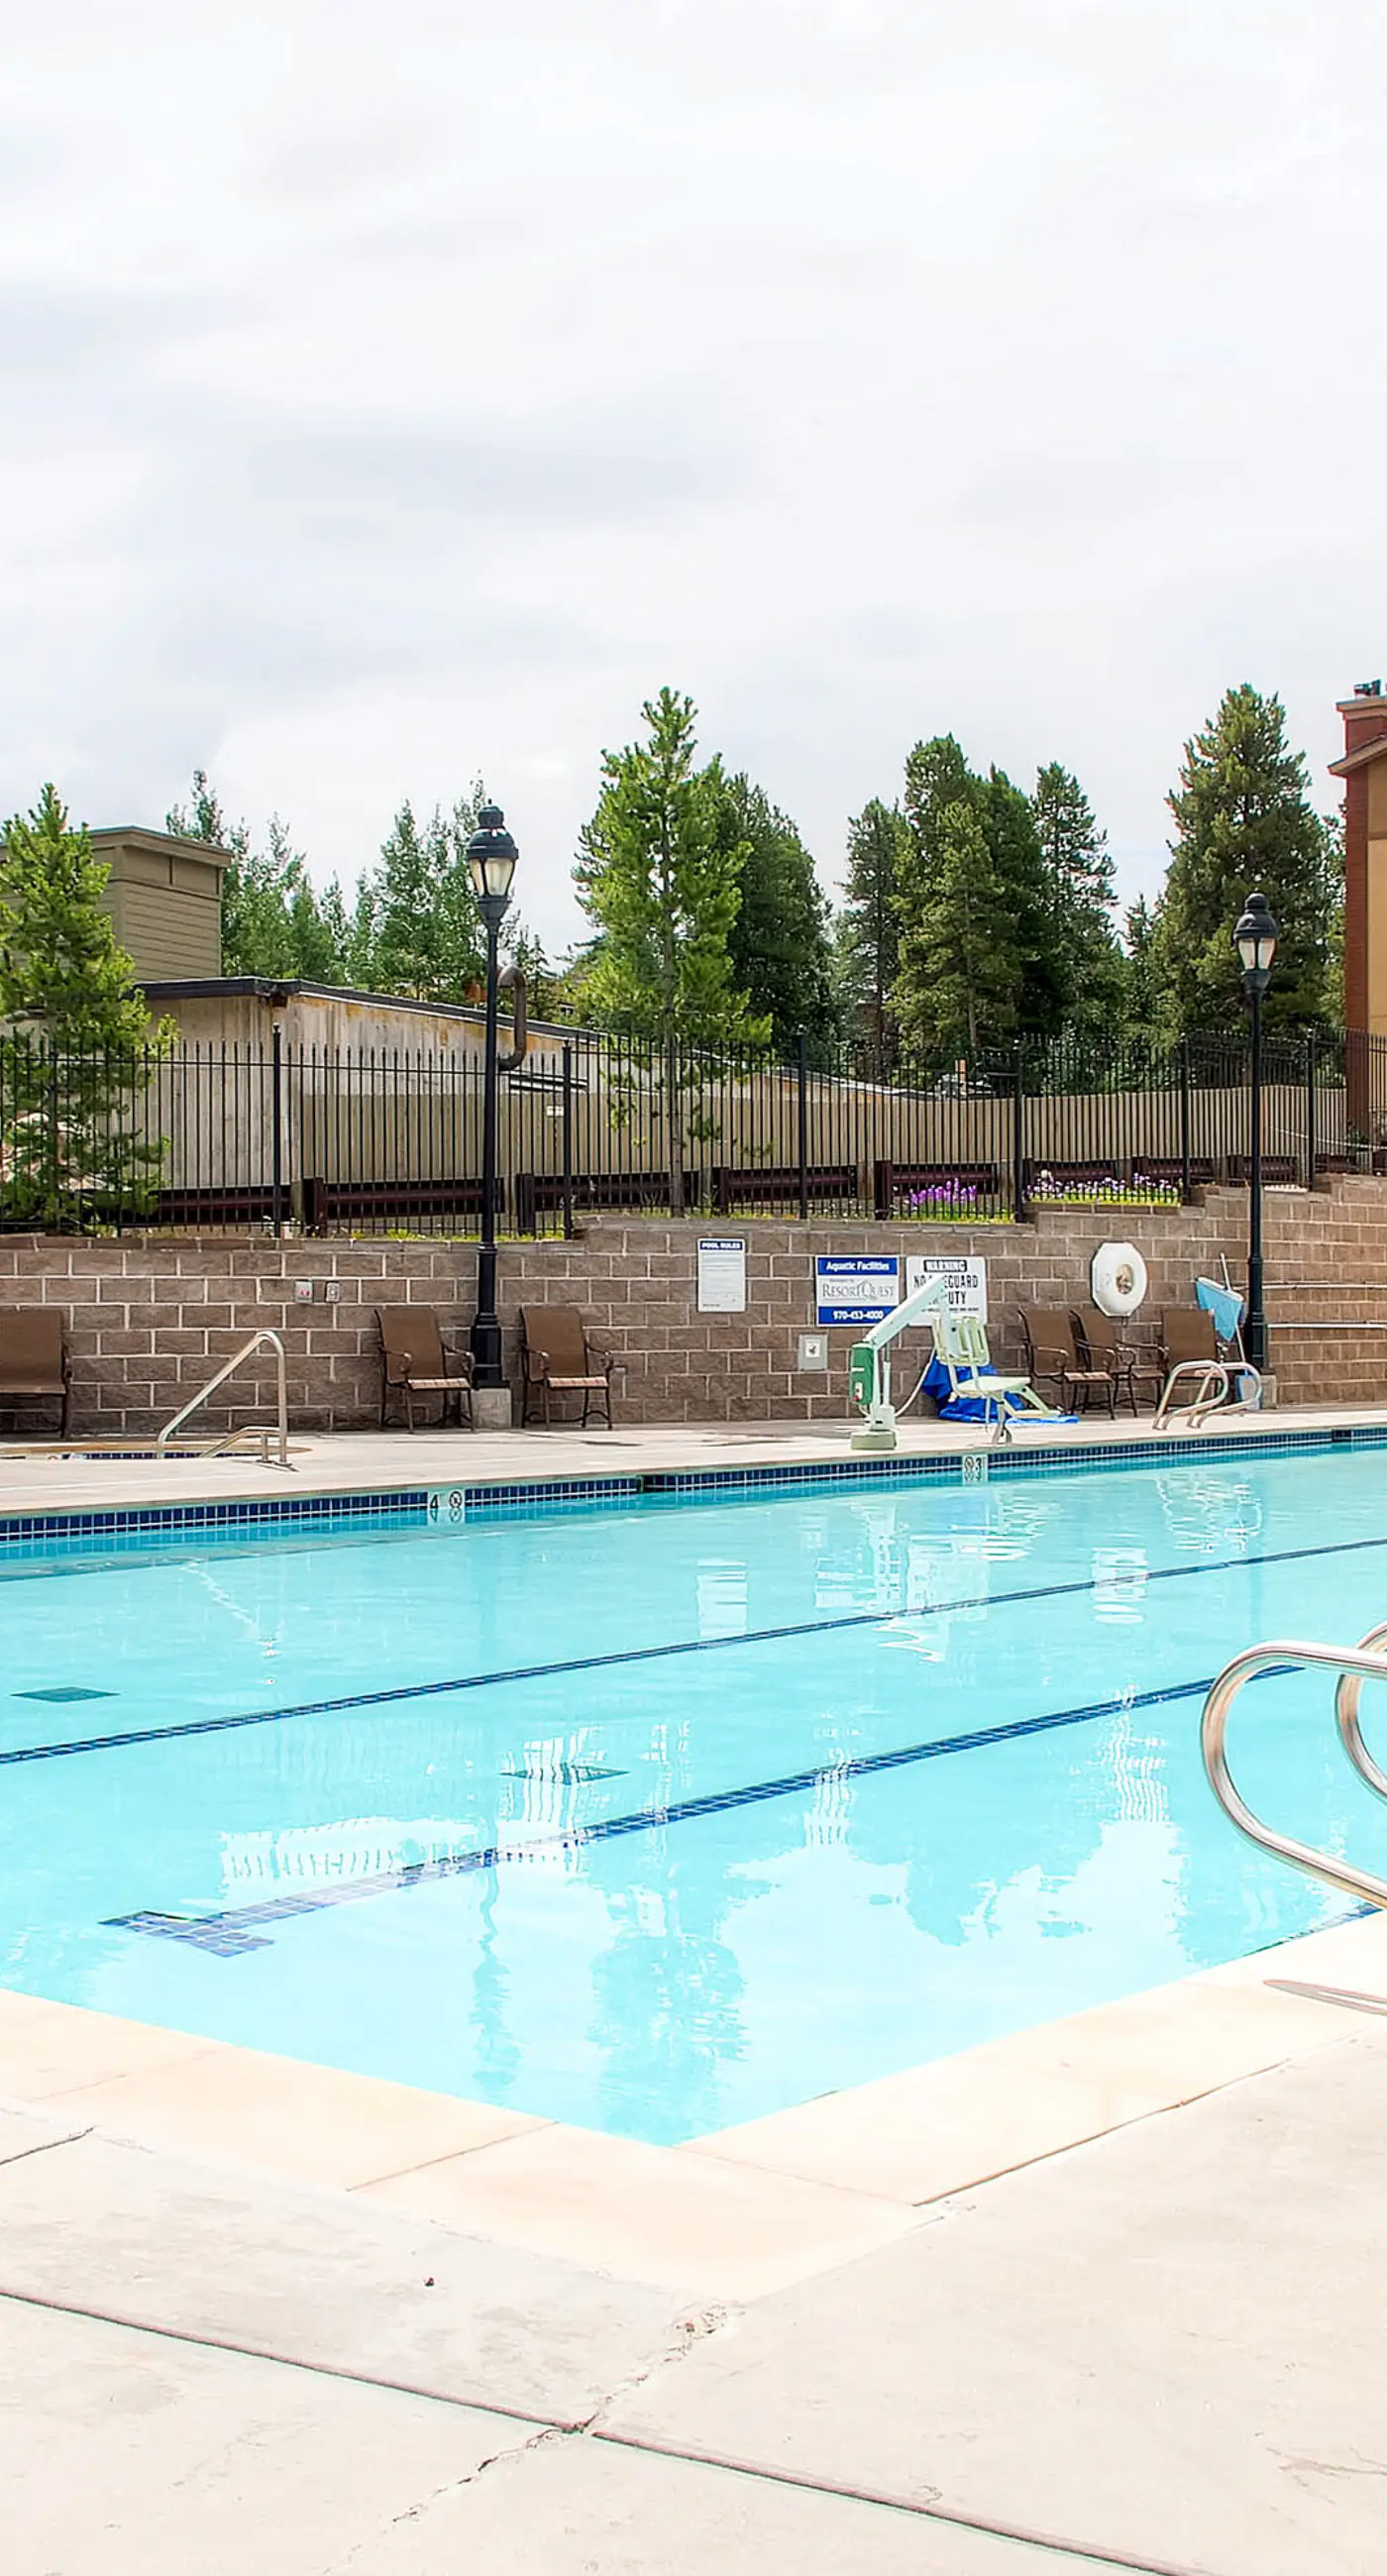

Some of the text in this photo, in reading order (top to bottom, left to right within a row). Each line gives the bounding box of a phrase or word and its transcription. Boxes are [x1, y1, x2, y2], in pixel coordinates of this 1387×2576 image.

[826, 1261, 890, 1272] Aquatic Facilities
[925, 1260, 966, 1272] WARNING
[948, 1290, 967, 1305] UTY
[430, 1493, 439, 1509] 4
